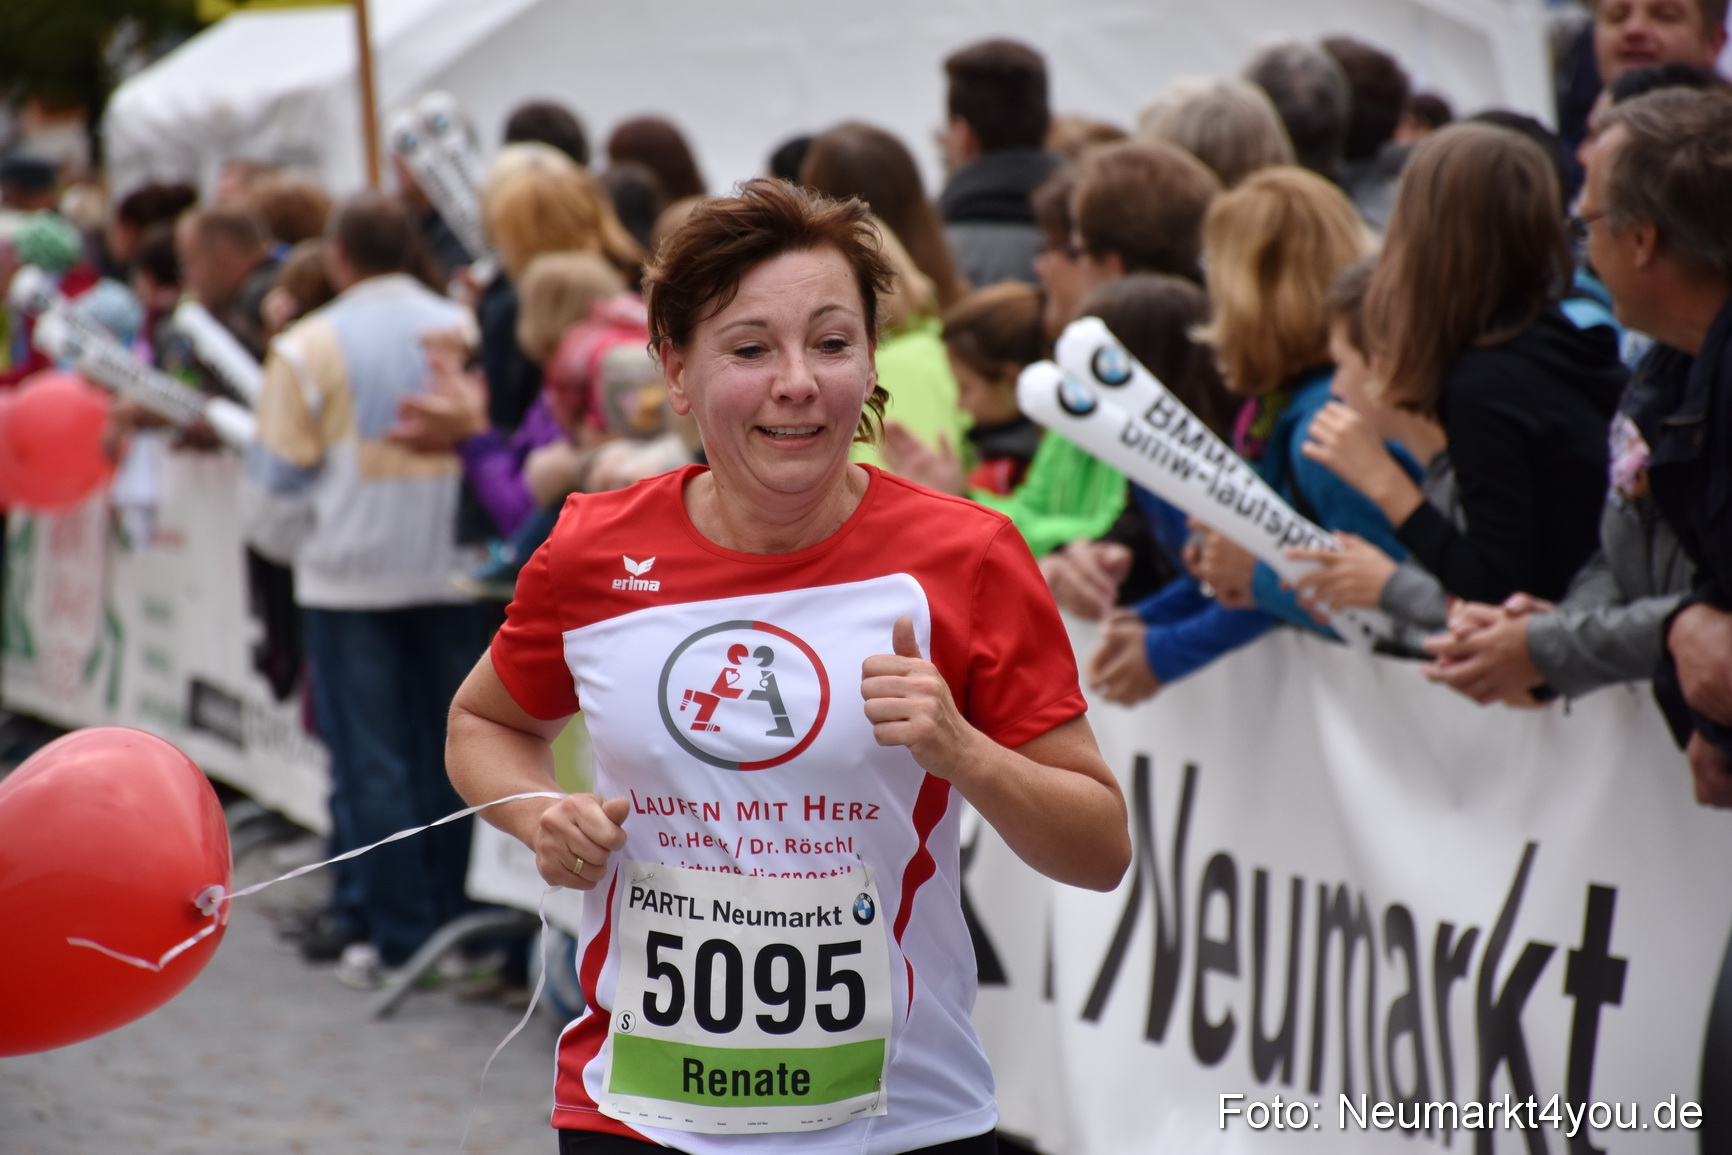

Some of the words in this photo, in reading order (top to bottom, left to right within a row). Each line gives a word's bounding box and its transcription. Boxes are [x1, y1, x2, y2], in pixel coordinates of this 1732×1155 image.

[611, 575, 661, 592] erima
[630, 789, 720, 822] LAUFEN
[737, 801, 788, 822] MIT
[804, 795, 881, 821] HERZ
[658, 832, 682, 848] Dr.
[735, 836, 743, 858] /
[750, 838, 779, 855] Dr.
[785, 836, 853, 855] Röschl
[629, 886, 704, 921] PARTL
[712, 899, 842, 928] Neumarkt
[1079, 754, 1628, 1155] Neumarkt
[642, 930, 866, 1035] 5095
[621, 1013, 631, 1030] S
[682, 1057, 811, 1097] Renate
